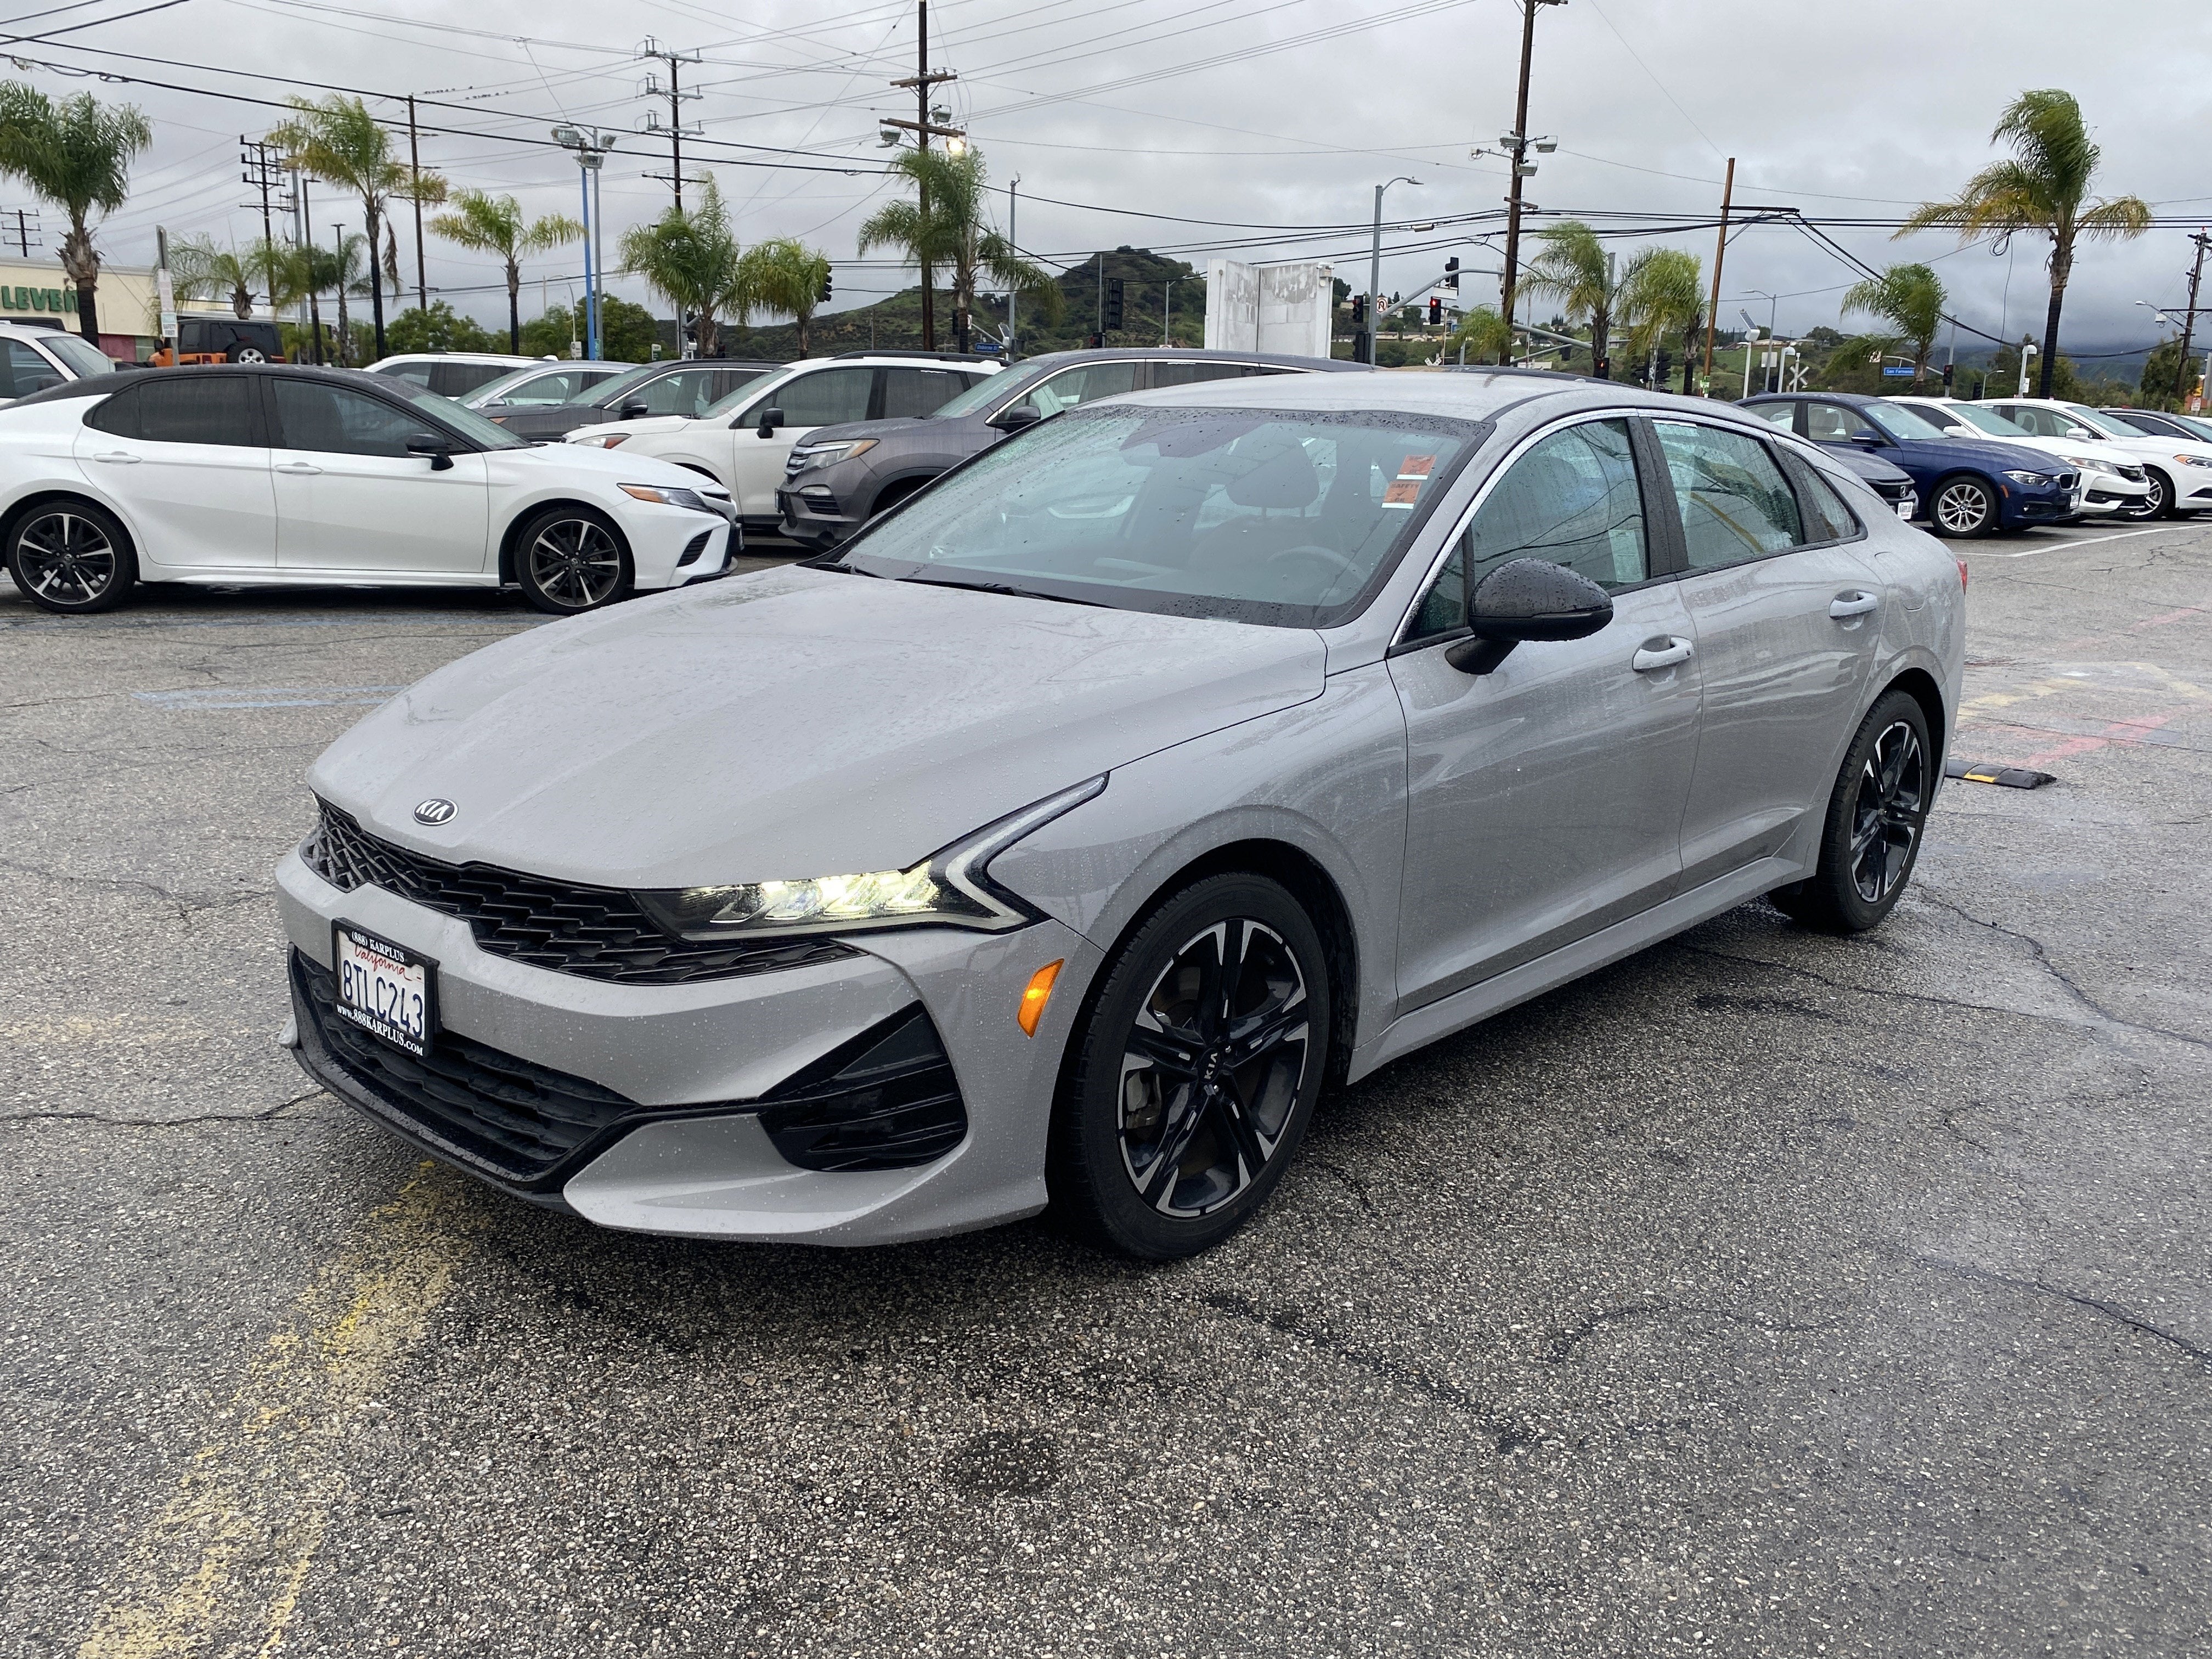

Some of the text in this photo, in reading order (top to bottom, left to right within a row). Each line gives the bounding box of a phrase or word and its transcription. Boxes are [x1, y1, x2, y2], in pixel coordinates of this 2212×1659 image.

[416, 800, 450, 820] KIA
[352, 931, 405, 962] (888) KARPLUS
[354, 943, 412, 981] California
[343, 960, 423, 1038] 8TLC243
[1204, 1052, 1218, 1080] KIA
